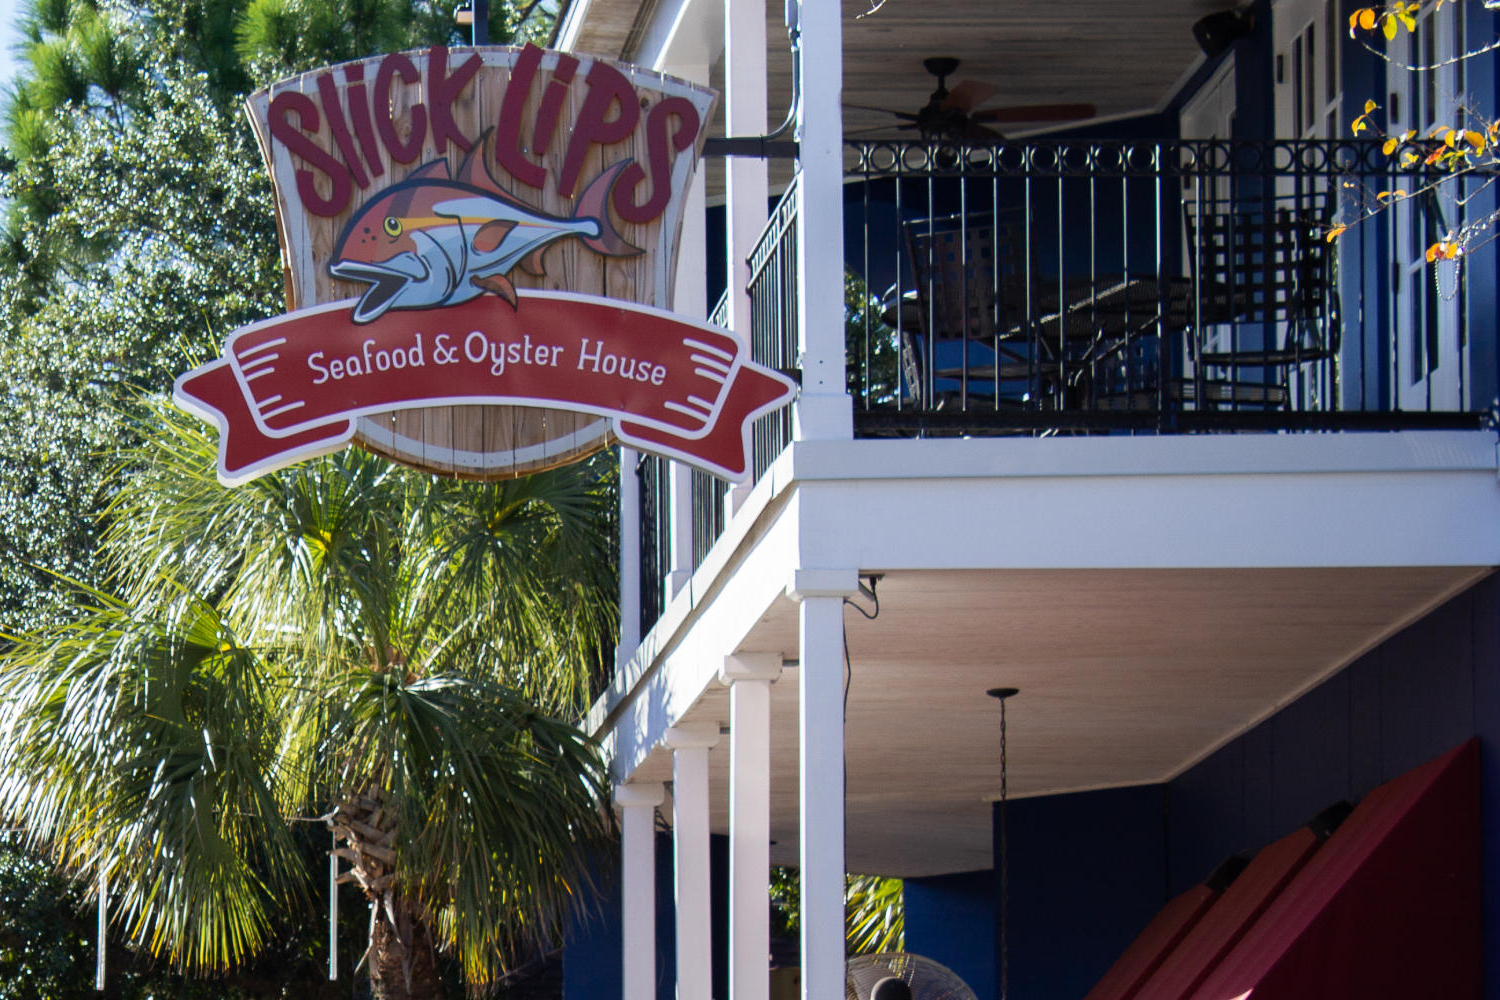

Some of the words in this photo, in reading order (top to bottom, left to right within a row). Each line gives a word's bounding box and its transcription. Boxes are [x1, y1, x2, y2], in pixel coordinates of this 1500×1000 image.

[308, 333, 425, 385] Seafood
[432, 335, 460, 365] &
[464, 331, 564, 377] Oyster
[577, 338, 667, 386] House
